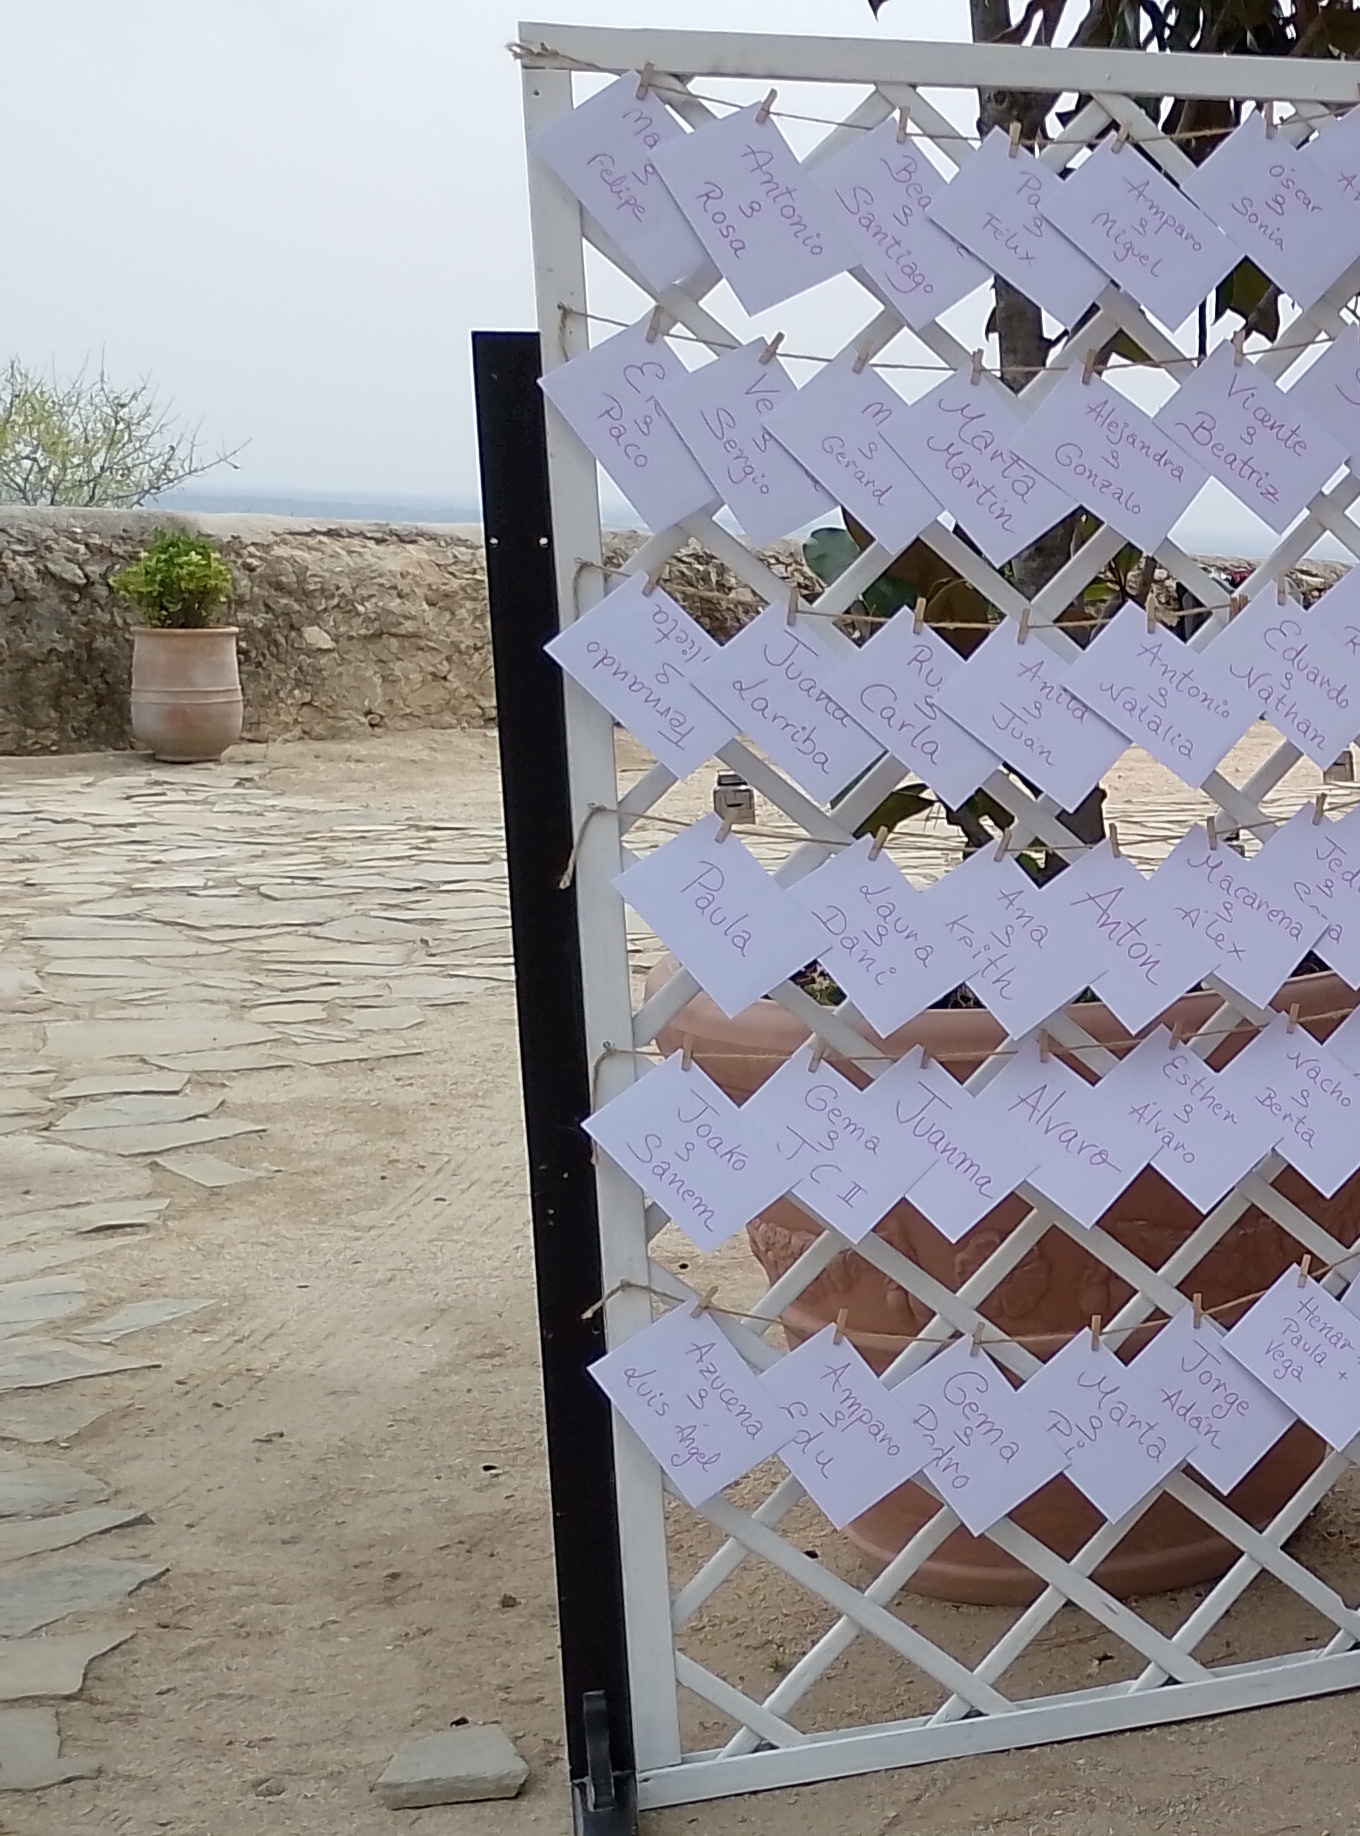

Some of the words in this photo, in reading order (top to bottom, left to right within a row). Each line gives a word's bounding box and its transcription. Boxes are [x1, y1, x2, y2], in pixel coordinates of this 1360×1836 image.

[588, 152, 647, 223] Felipe
[696, 181, 747, 259] Rosa
[741, 144, 824, 257] Antonio
[1123, 177, 1202, 251] Amparo
[1231, 197, 1285, 252] Sonia
[834, 186, 934, 295] Santiago
[1092, 212, 1162, 278] Miguel
[598, 392, 648, 467] Paco
[700, 407, 770, 495] Sergio
[938, 398, 1036, 505] Marta
[1085, 399, 1185, 483] Alejandra
[1227, 372, 1308, 457] Vicente
[821, 435, 893, 507] Gerard
[1055, 443, 1142, 515] Gonzalo
[1175, 411, 1281, 505] Beatriz
[586, 640, 695, 751] Fernando
[1136, 643, 1230, 719] Antonio
[1263, 620, 1350, 709] Eduardo
[732, 678, 830, 775] Larriba
[860, 684, 939, 766] Carla
[1100, 682, 1196, 760] Natalia
[1229, 664, 1325, 750] Nathan
[680, 861, 752, 958] Paula
[859, 885, 934, 968] Laura
[997, 889, 1049, 948] Ana
[1187, 854, 1303, 942] Macarena
[811, 905, 898, 986] Dani
[804, 1084, 880, 1155] Gema
[1162, 1055, 1237, 1125] Esther
[1255, 1086, 1316, 1150] Berta
[1286, 1052, 1352, 1108] Nacho
[677, 1088, 747, 1171] Joako
[896, 1080, 995, 1200] Juanma
[627, 1134, 714, 1232] Sanem
[1265, 1339, 1304, 1383] Vega
[1282, 1317, 1328, 1368] Paula
[1296, 1296, 1355, 1351] Henar
[623, 1367, 669, 1417] Luis
[685, 1342, 764, 1440] Azucena
[820, 1362, 900, 1457] Amparo
[943, 1371, 1020, 1465] Gema
[1077, 1371, 1167, 1463] Marta
[1181, 1339, 1250, 1420] Jorge
